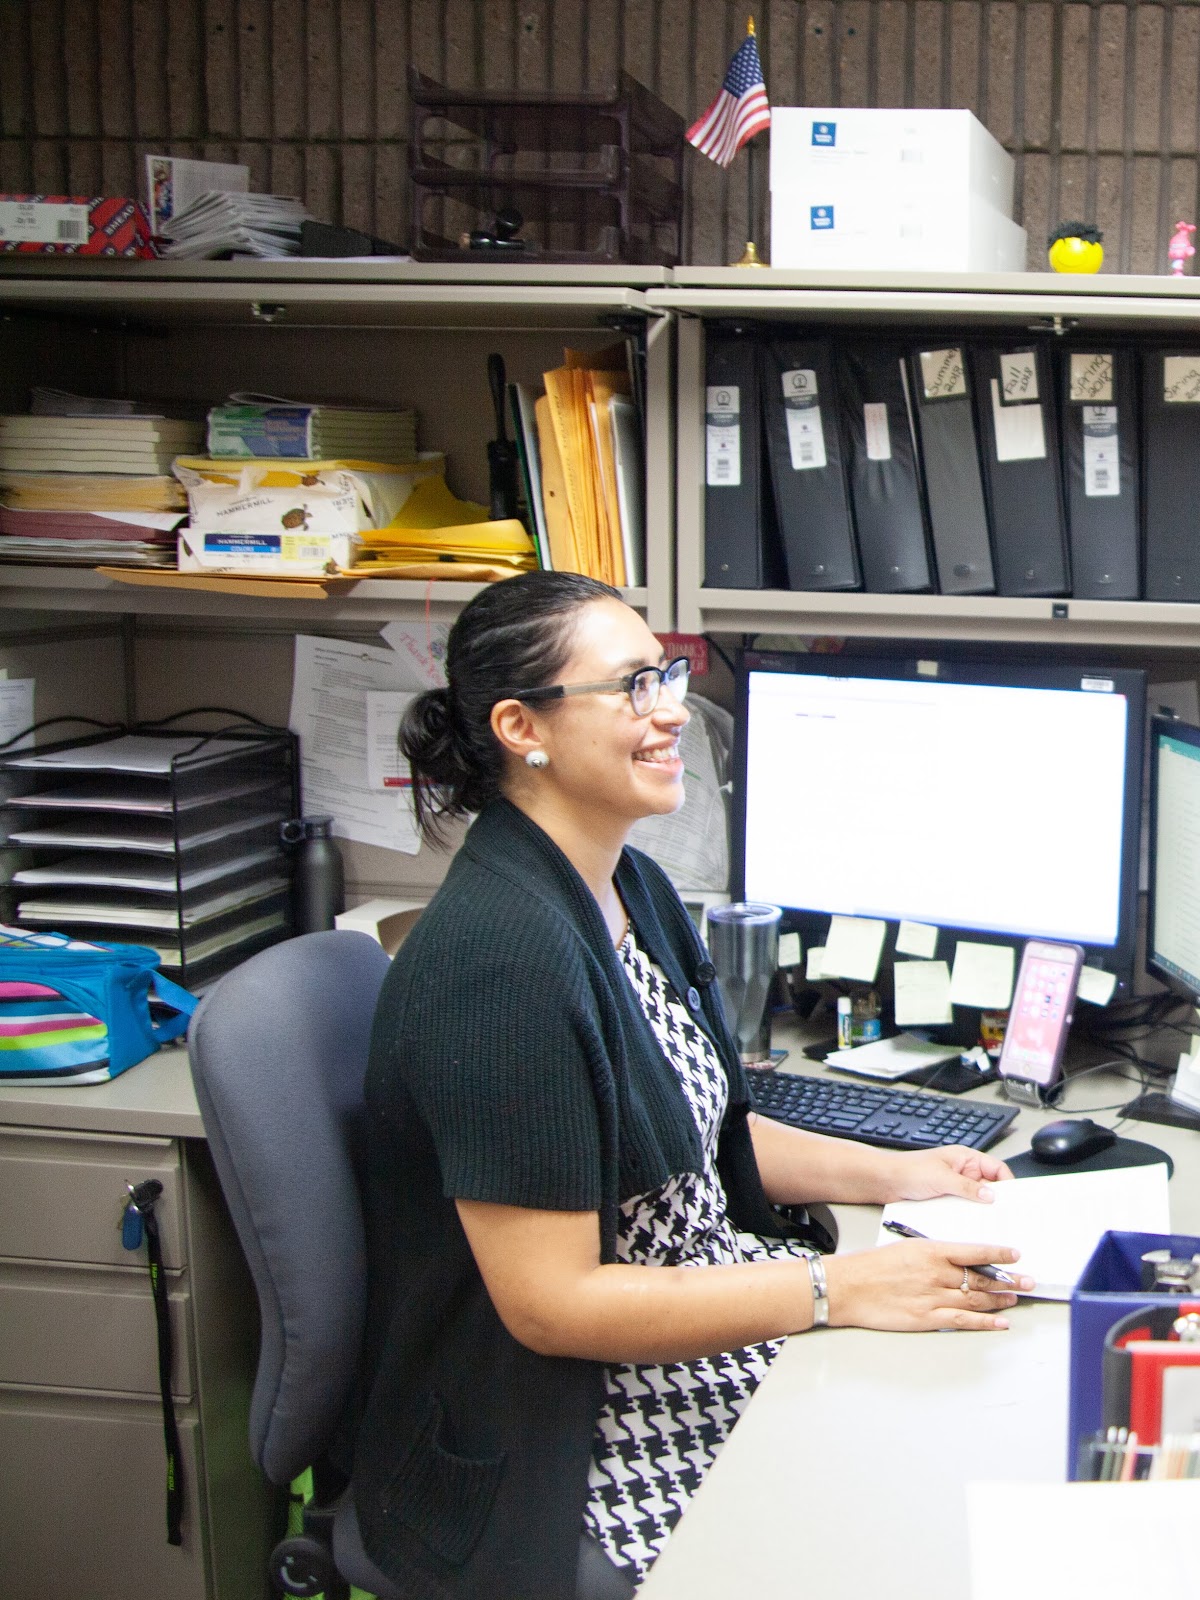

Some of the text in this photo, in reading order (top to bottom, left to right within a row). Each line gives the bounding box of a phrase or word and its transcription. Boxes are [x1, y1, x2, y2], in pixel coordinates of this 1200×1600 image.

[103, 204, 136, 236] SMEAD
[929, 347, 960, 397] Summer
[944, 365, 965, 392] 2018
[1005, 366, 1021, 395] Fall
[1020, 366, 1034, 393] 2018
[216, 498, 274, 517] HAMMERMILL
